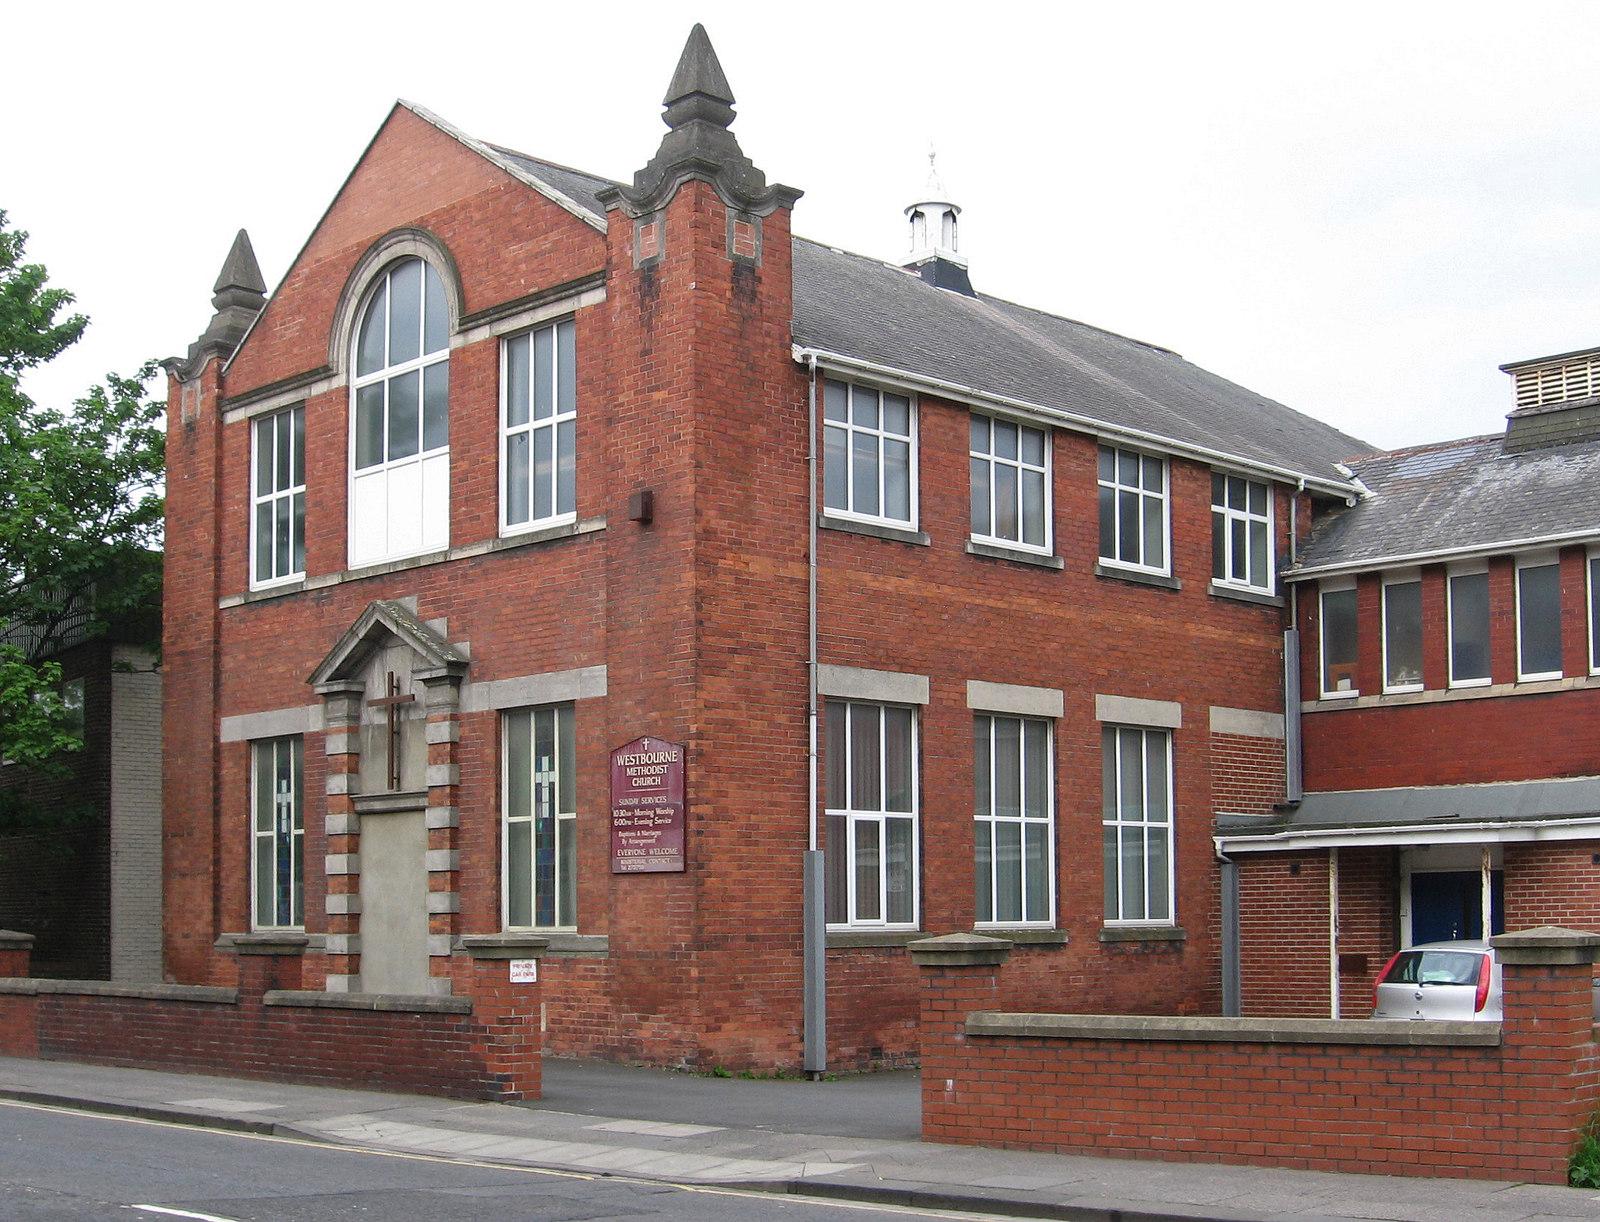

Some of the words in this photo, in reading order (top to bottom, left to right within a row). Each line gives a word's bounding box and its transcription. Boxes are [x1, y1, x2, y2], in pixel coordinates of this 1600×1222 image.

[617, 751, 678, 766] WESTBOURNE
[626, 765, 669, 776] METHODIST
[631, 777, 661, 787] CHURCH
[619, 798, 638, 806] SUNDAY
[641, 796, 667, 804] SERVICES
[655, 807, 675, 816] Worship
[654, 816, 672, 825] Service
[617, 848, 647, 856] EVERYONE
[649, 847, 679, 855] WELCOME
